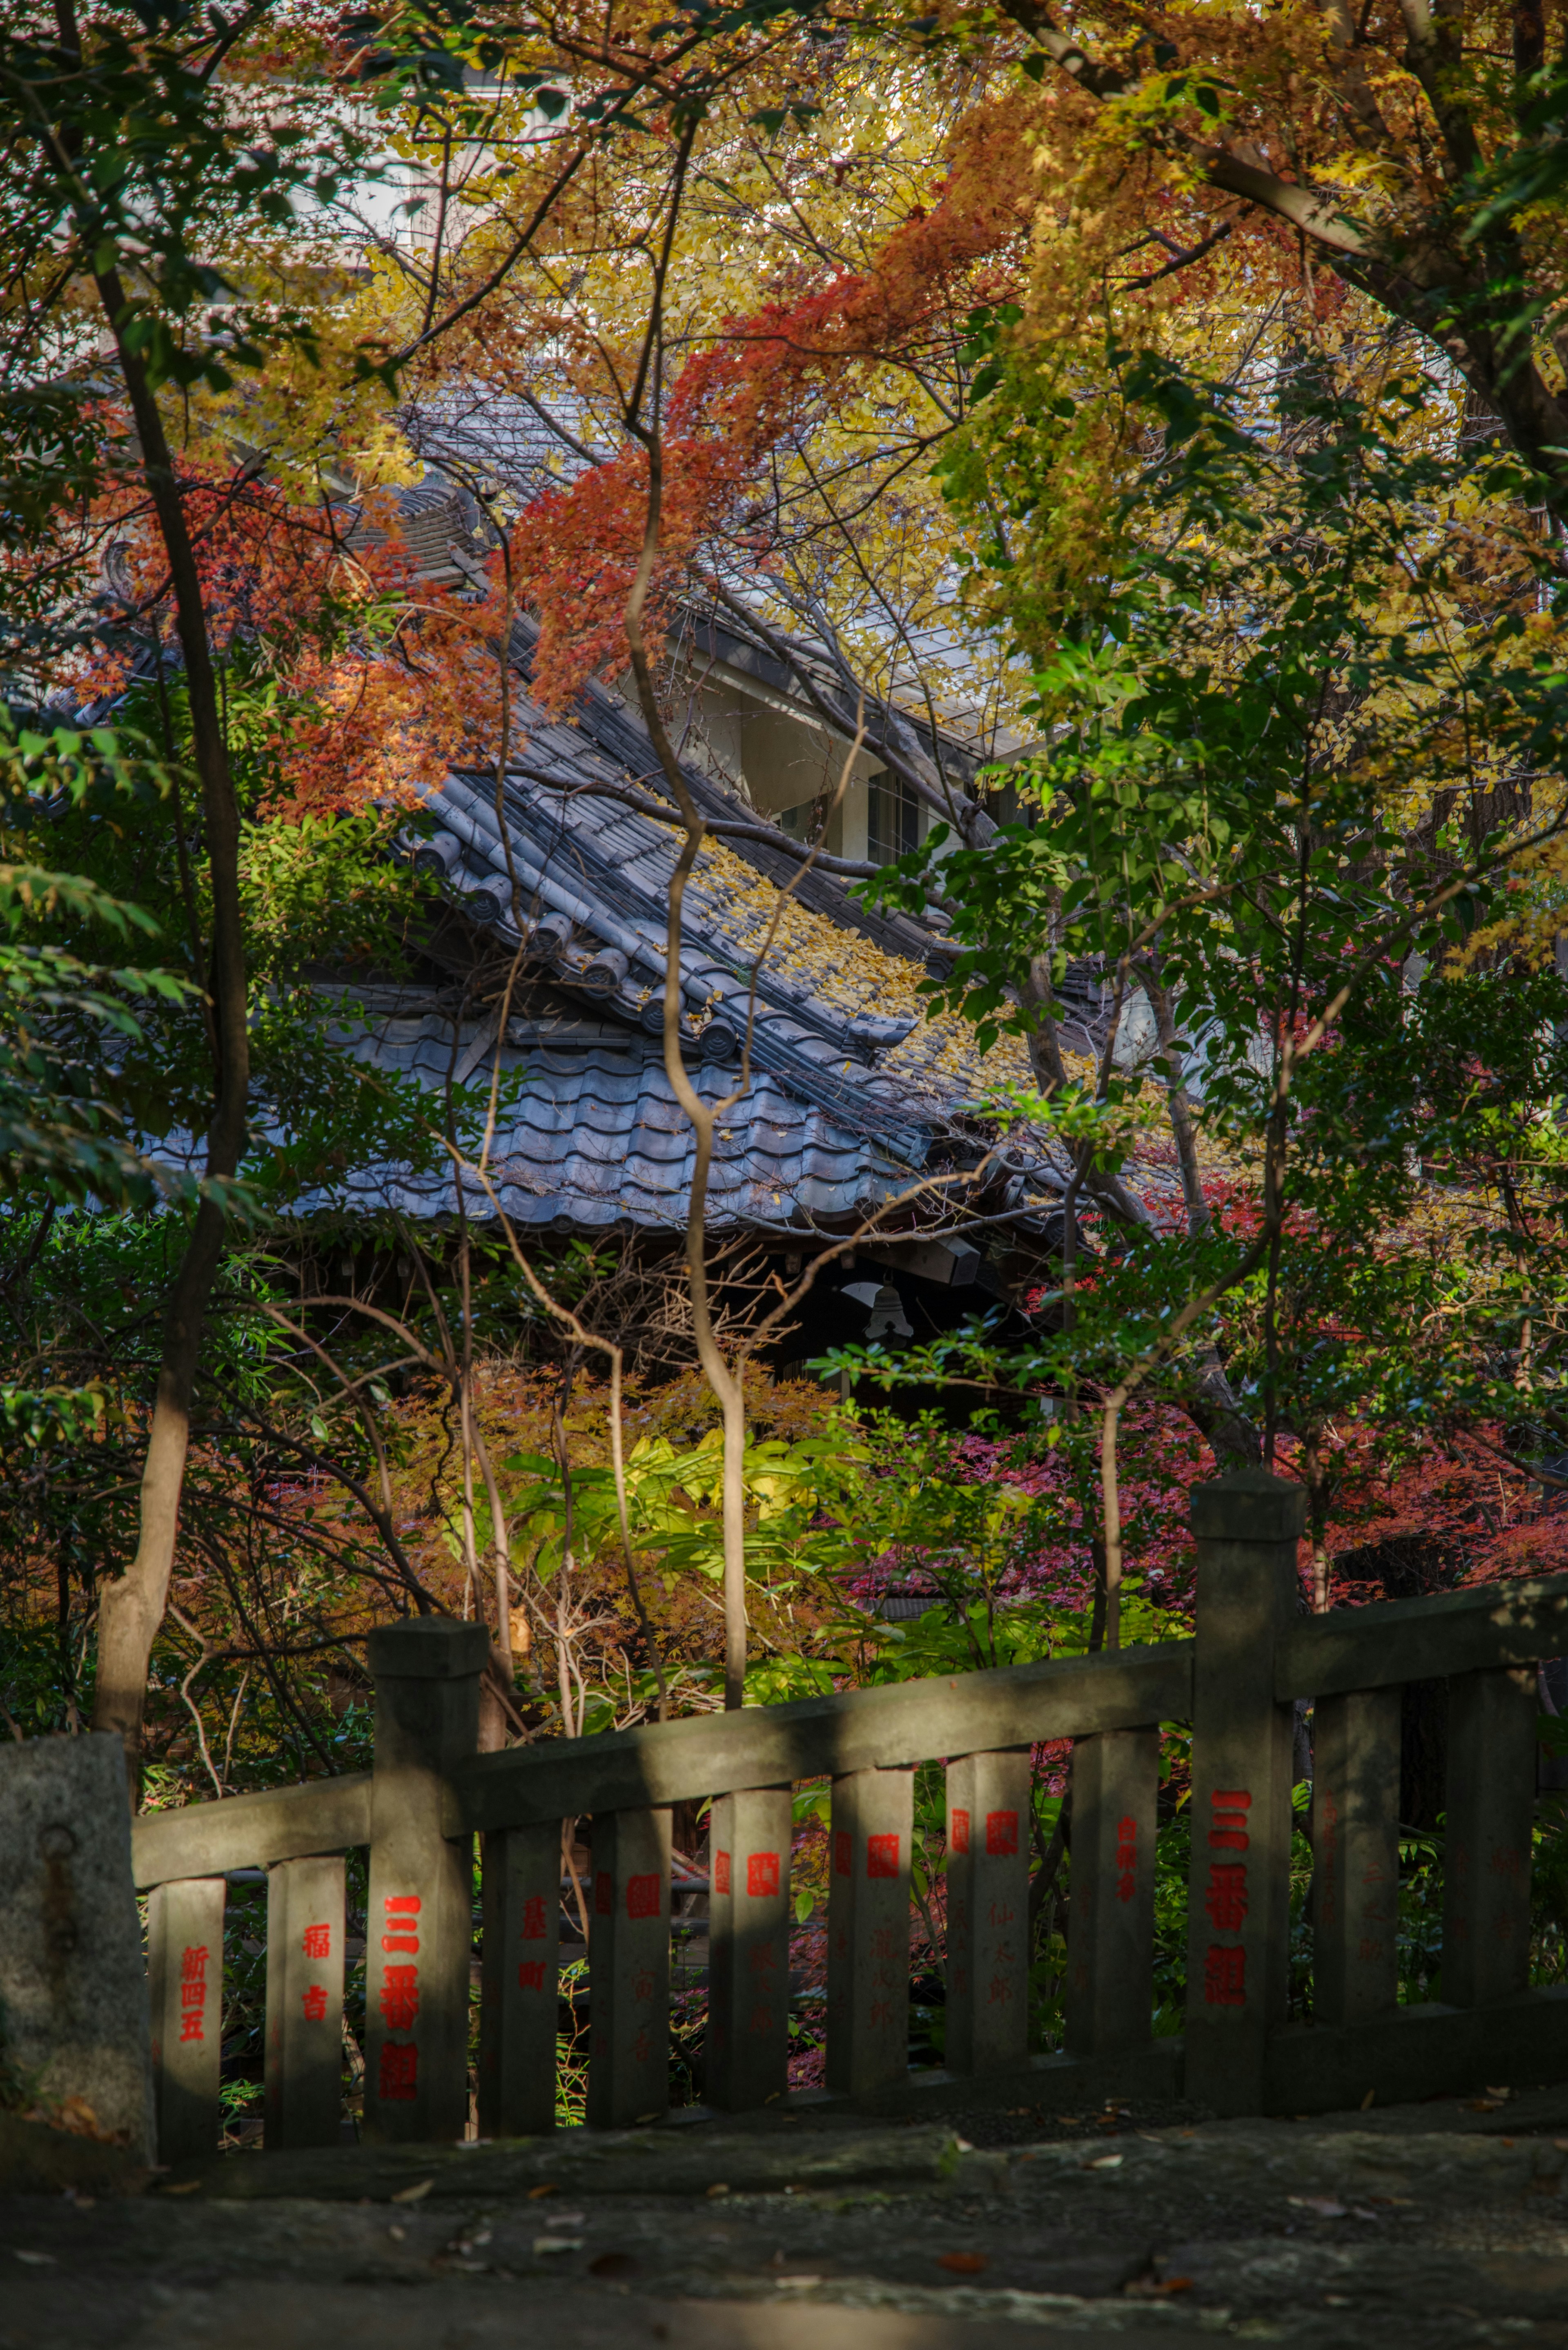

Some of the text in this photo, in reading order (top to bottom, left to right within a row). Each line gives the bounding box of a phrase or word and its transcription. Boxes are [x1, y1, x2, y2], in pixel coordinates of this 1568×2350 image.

[302, 1924, 330, 2021] 福吉
[1204, 1790, 1252, 2005] 三番組
[180, 1946, 209, 2042] 新四五
[379, 1896, 421, 2100] 三番組
